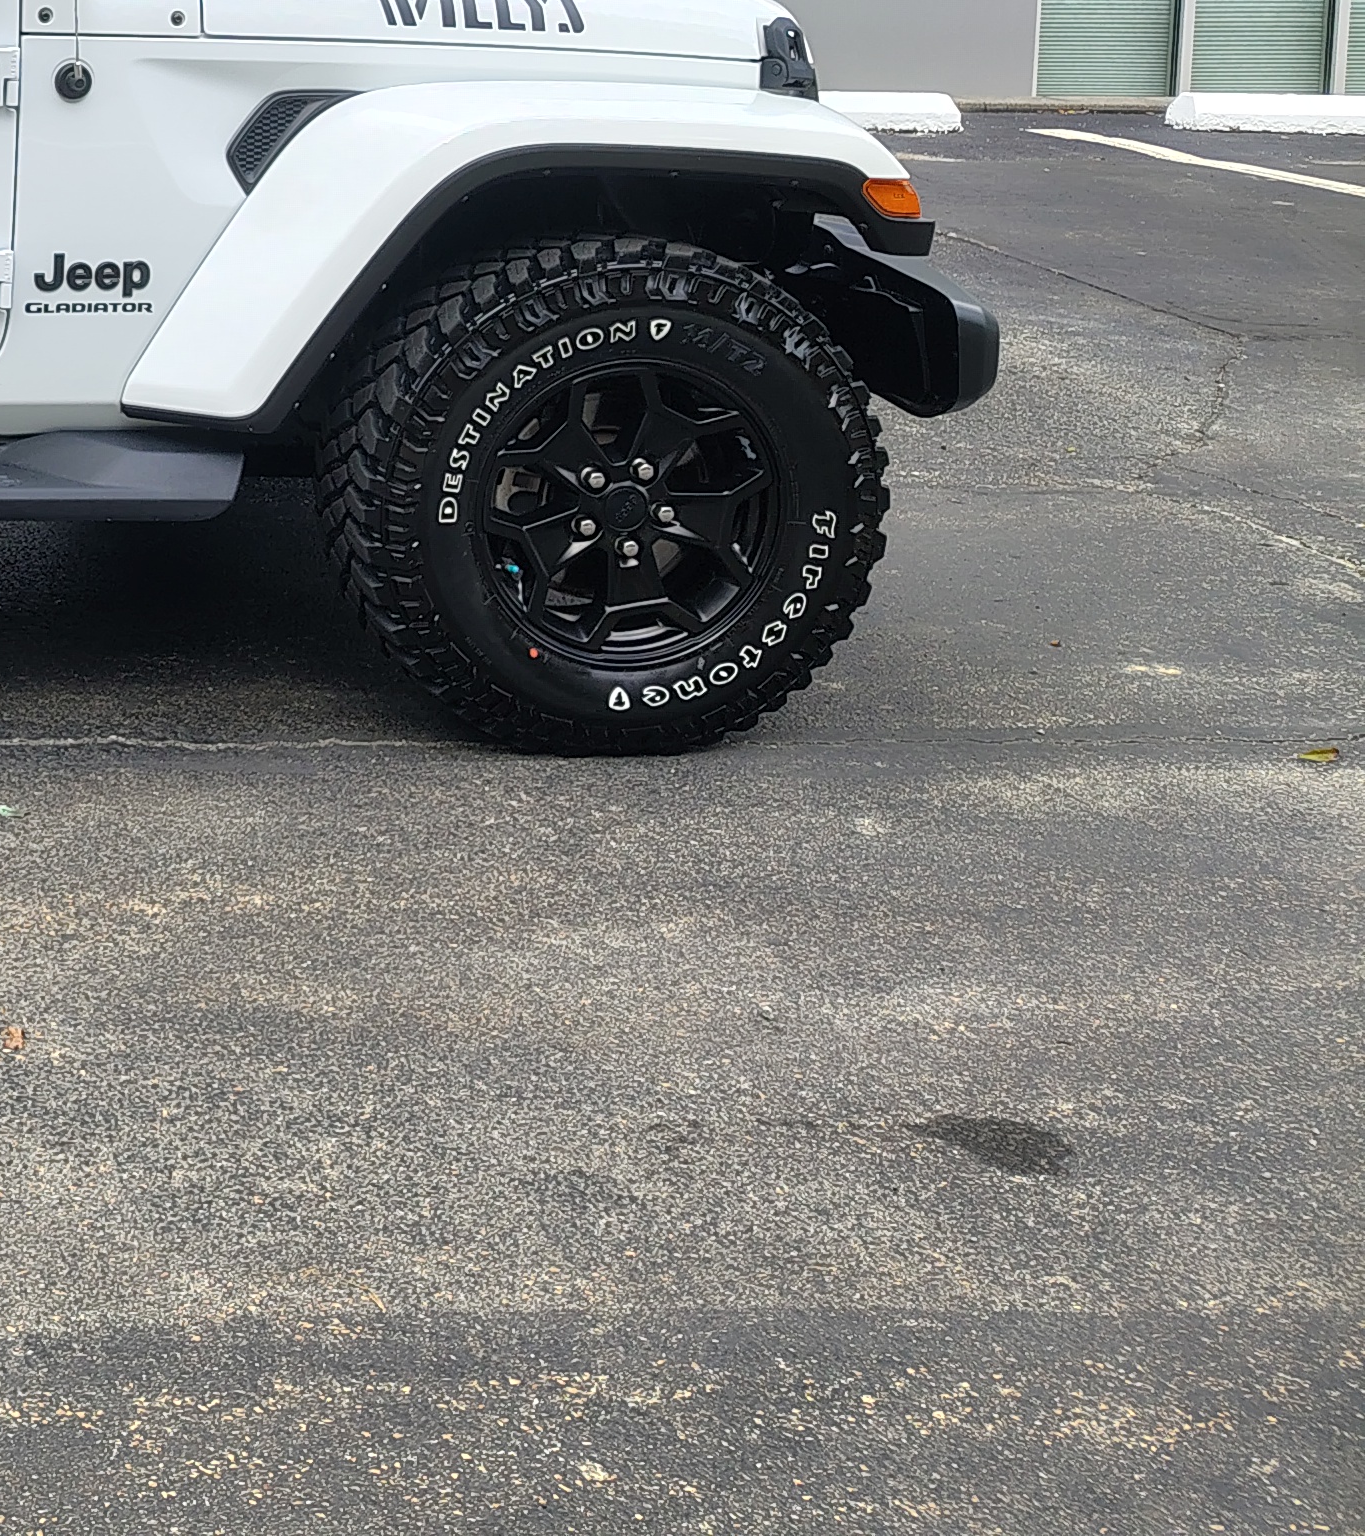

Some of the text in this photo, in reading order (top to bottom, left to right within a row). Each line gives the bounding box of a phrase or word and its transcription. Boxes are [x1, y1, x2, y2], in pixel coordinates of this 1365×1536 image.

[25, 302, 153, 314] GLADIATOR
[34, 252, 151, 298] Jeep
[437, 319, 637, 524] DESTINATION
[640, 510, 838, 707] Firestone
